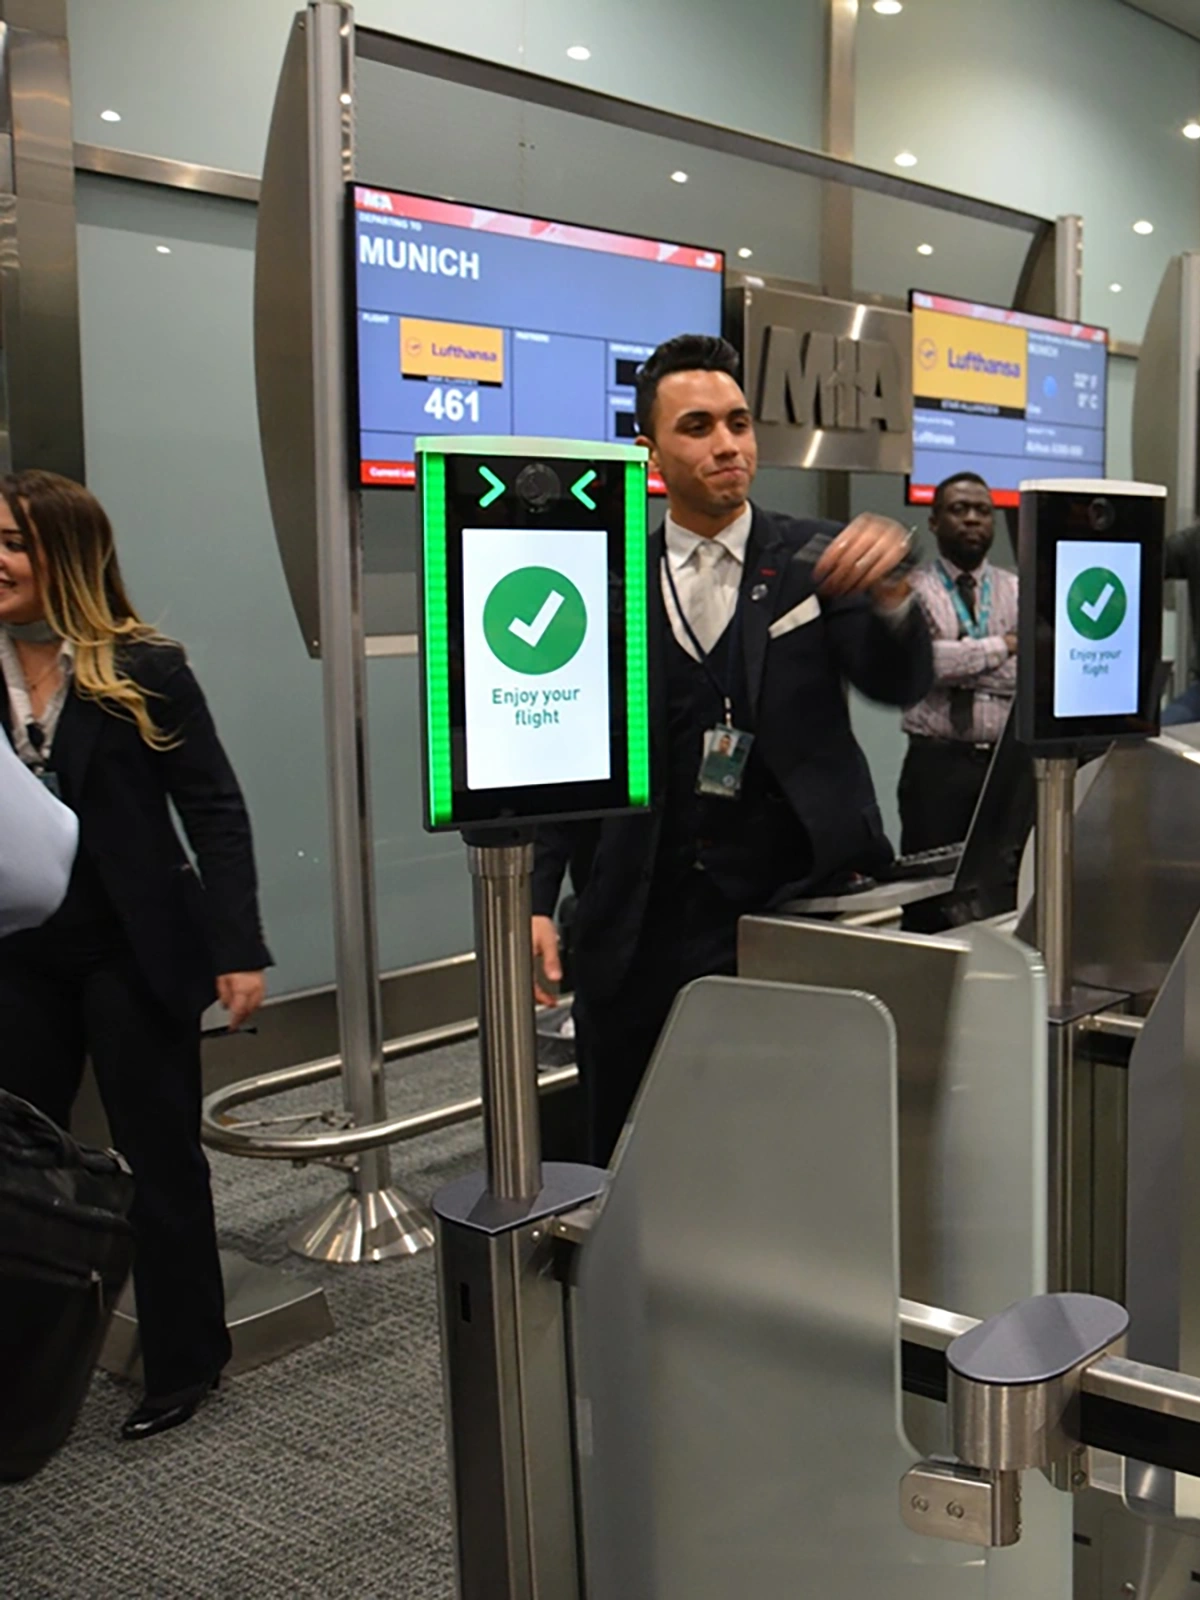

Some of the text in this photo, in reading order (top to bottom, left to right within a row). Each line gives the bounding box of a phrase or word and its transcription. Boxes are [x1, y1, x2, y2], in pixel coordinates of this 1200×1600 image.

[359, 234, 480, 281] MUNICH
[431, 343, 498, 362] Lufthansa
[947, 347, 1021, 380] Lufthansa
[424, 387, 480, 422] 461
[1069, 648, 1121, 662] Enjoy your
[1082, 663, 1109, 678] flight
[492, 687, 580, 706] Enjoy your
[515, 708, 560, 728] flight
